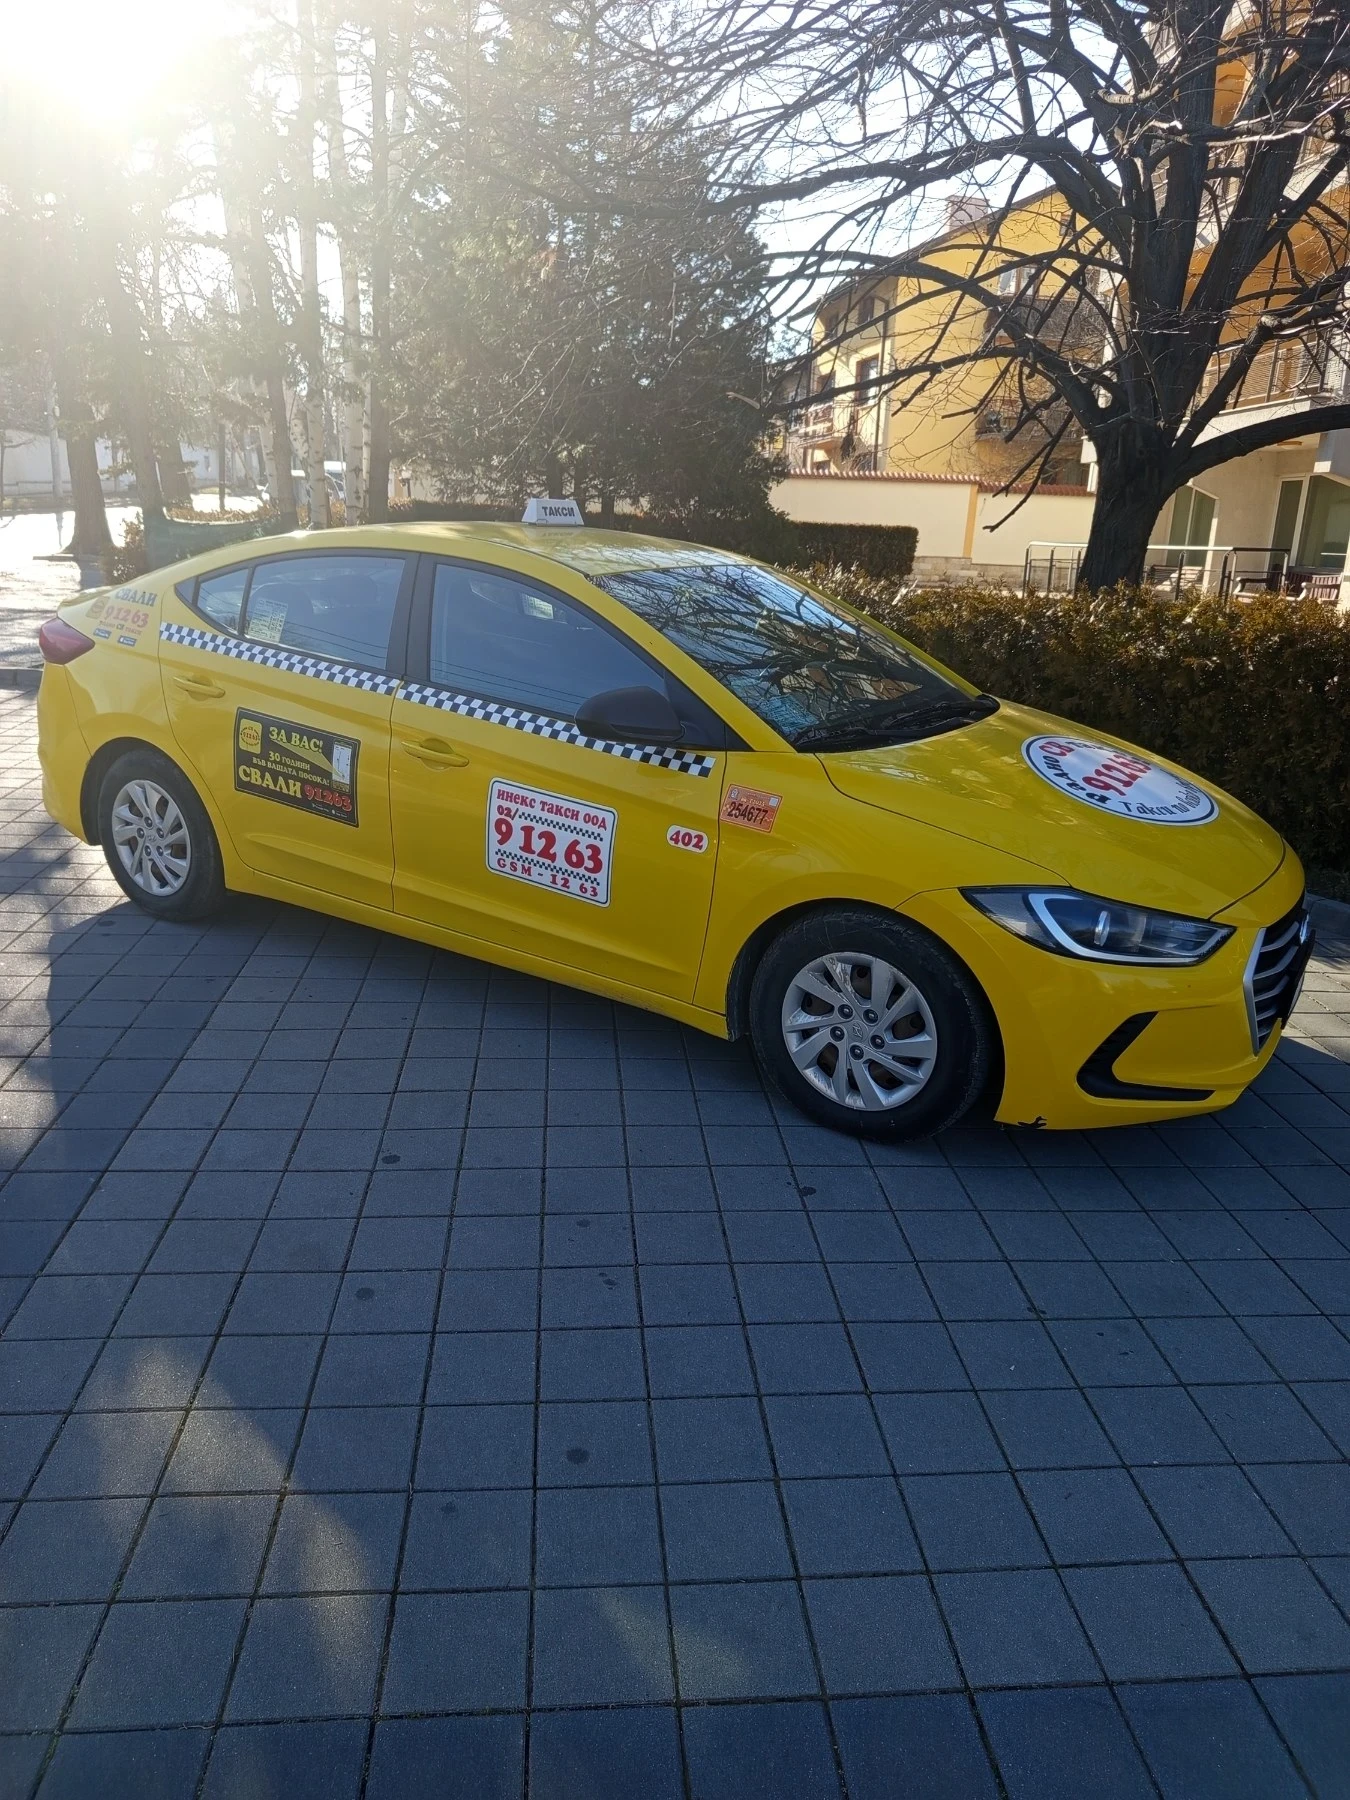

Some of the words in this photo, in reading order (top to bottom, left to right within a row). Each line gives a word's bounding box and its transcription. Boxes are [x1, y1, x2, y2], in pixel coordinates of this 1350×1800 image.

[541, 506, 576, 517] ТАКСИ
[115, 588, 157, 607] СВАЛИ
[104, 605, 149, 628] 91263
[269, 727, 287, 743] ЗА
[291, 732, 324, 753] ВАС!
[268, 751, 281, 762] 30
[267, 761, 298, 777] ВАШАТА
[239, 765, 302, 798] СВАЛИ
[304, 784, 352, 812] 91263
[496, 805, 519, 820] 02/
[727, 801, 768, 825] 254677
[669, 830, 704, 850] 402
